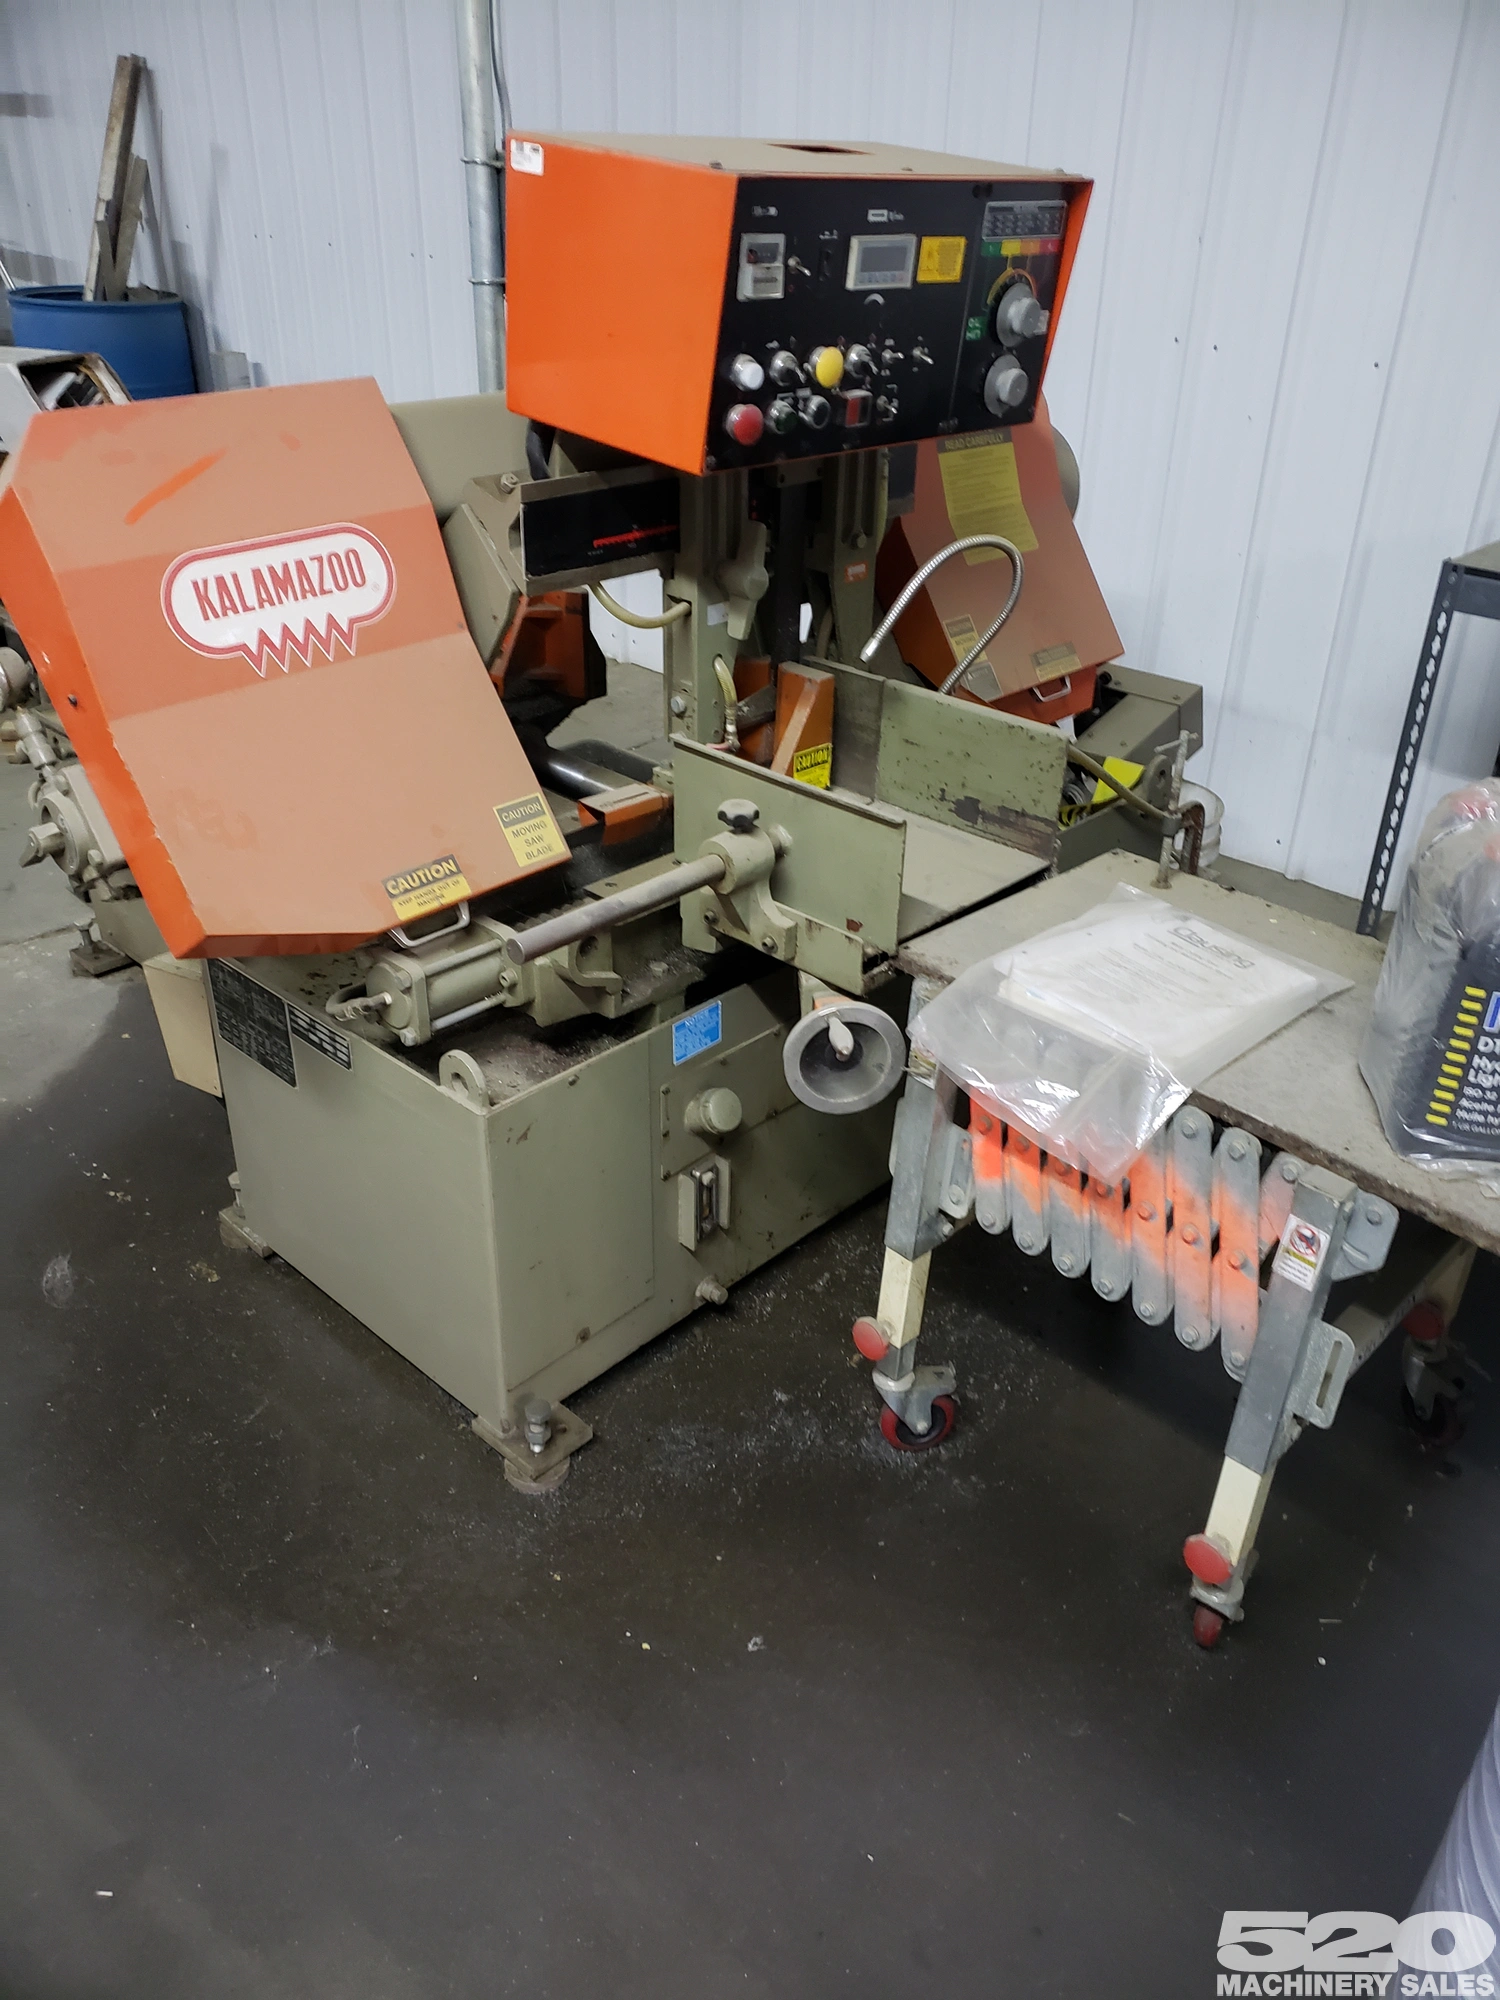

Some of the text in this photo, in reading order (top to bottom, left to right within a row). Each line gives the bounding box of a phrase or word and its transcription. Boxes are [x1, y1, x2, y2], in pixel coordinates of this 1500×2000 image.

[191, 548, 366, 621] KALAMAZOO
[502, 802, 542, 822] CAUTION
[511, 820, 547, 839] MOVING
[524, 834, 545, 848] SAW
[525, 844, 553, 860] BLADE
[386, 858, 458, 895] CAUTION
